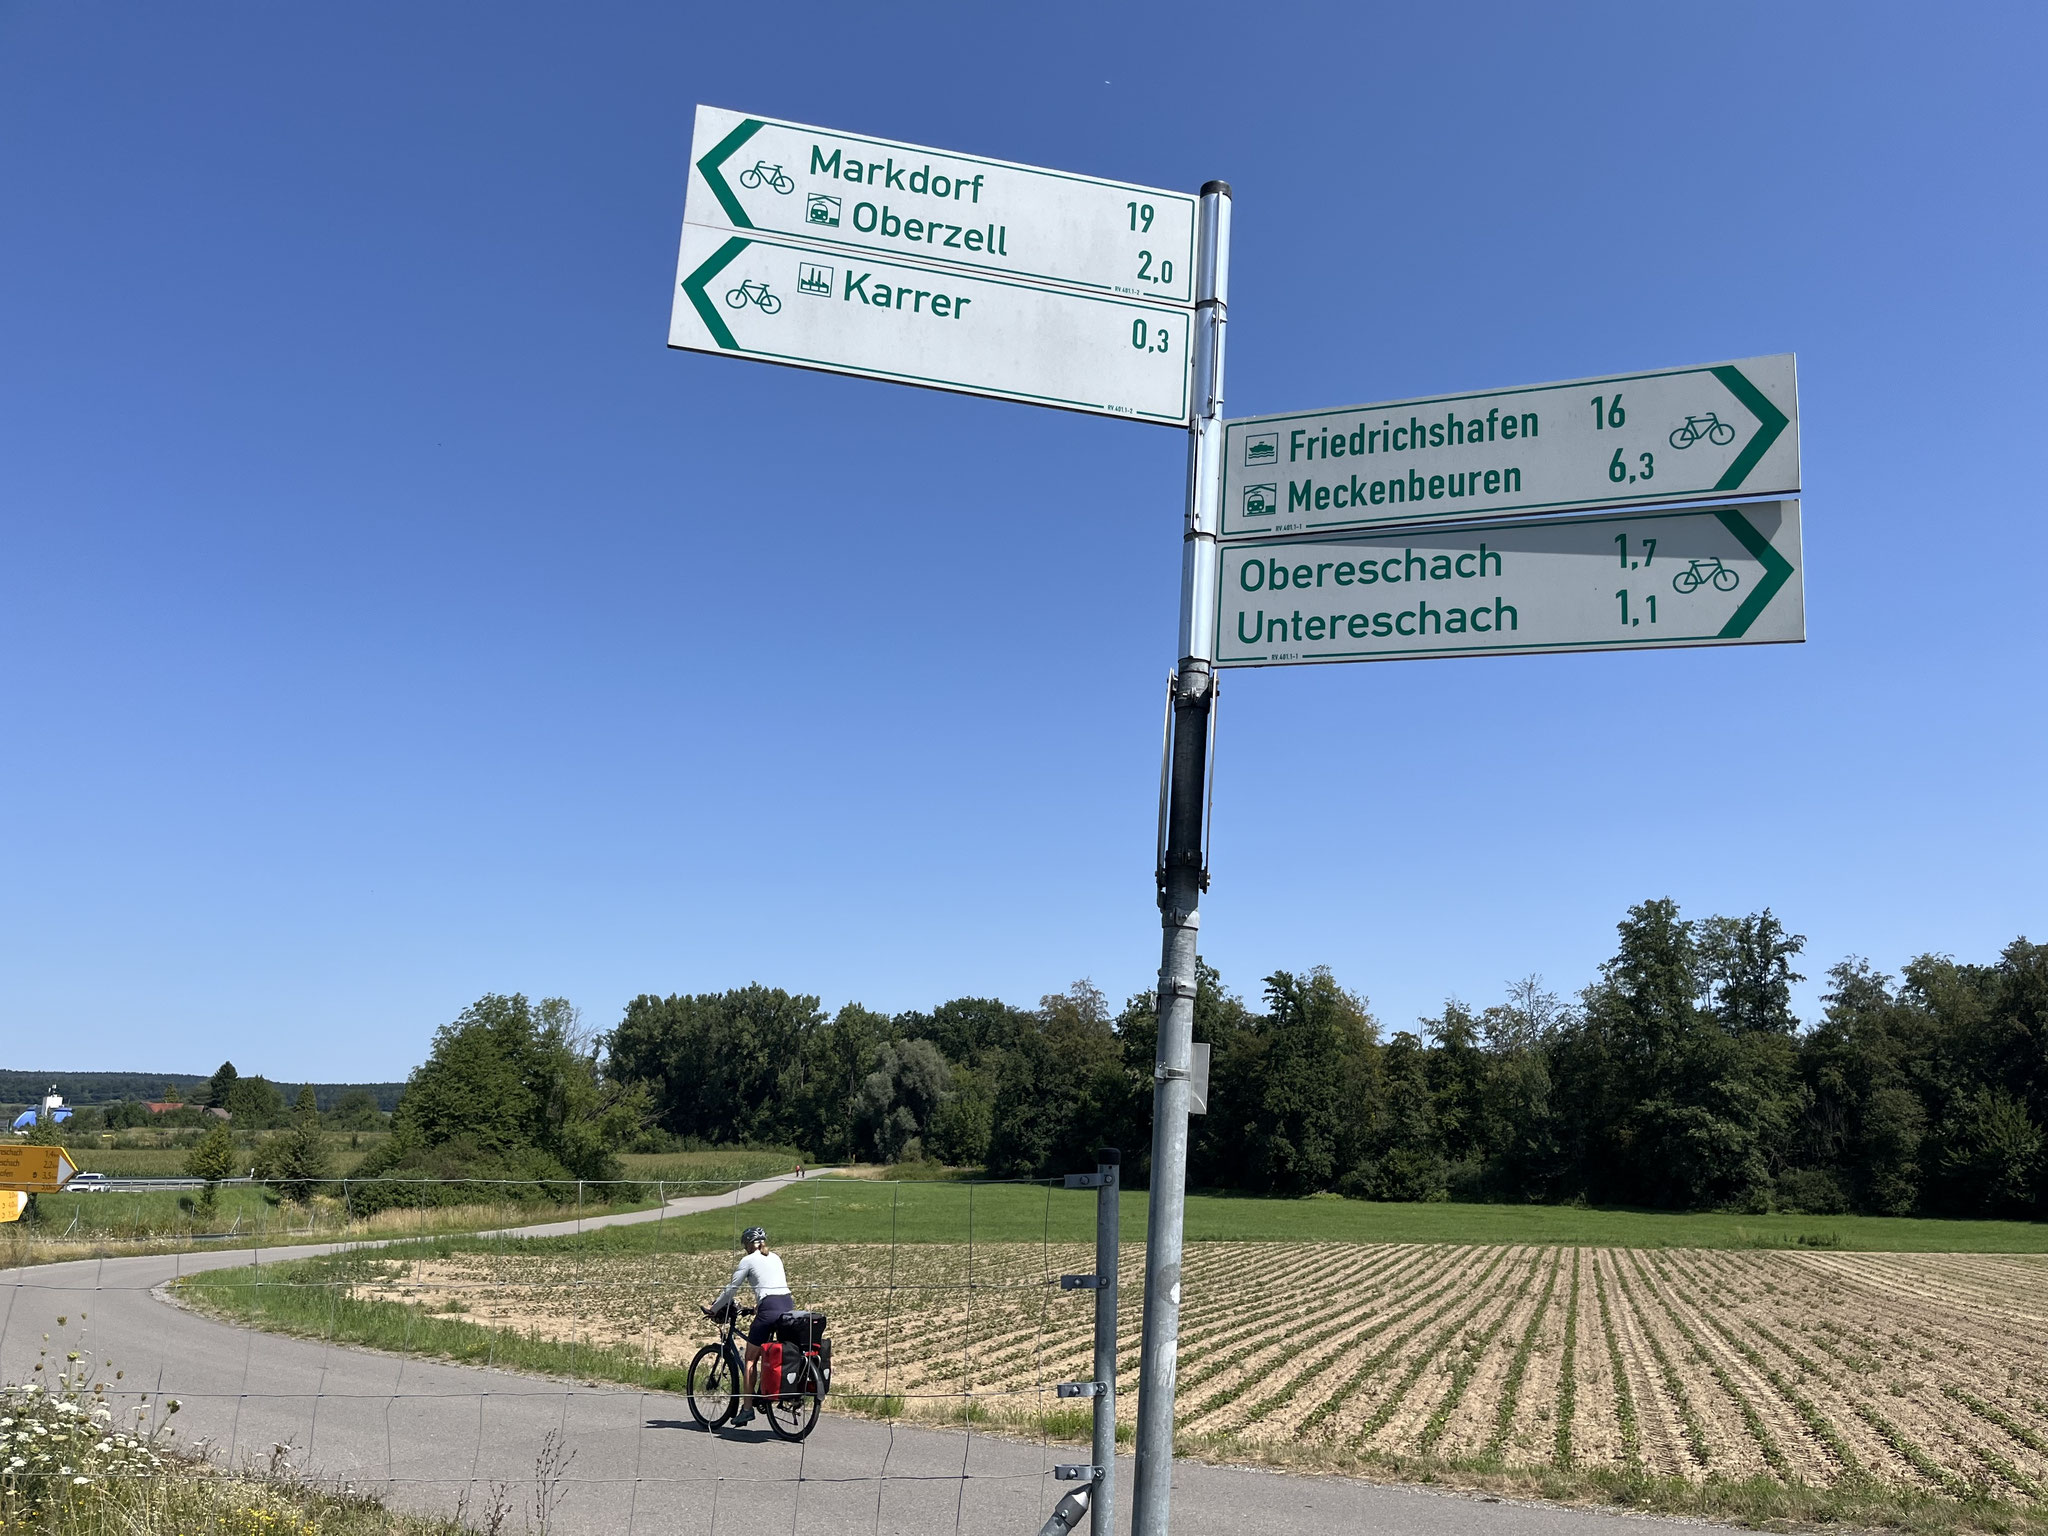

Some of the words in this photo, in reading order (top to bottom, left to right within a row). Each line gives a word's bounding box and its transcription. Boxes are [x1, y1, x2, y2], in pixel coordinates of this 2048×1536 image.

[810, 144, 986, 204] Markdorf
[1127, 200, 1156, 234] 19
[852, 200, 1009, 257] Oberzell
[1136, 249, 1174, 285] 2,0
[844, 269, 972, 321] Karrer
[1132, 317, 1170, 355] 0,3
[1289, 410, 1540, 464] Friedrichshafen
[1591, 393, 1626, 429] 16
[1287, 467, 1522, 513] Meckenbeuren
[1608, 446, 1655, 485] 6,3
[1239, 543, 1503, 592] Obereschach
[1614, 533, 1658, 570] 1,7
[1237, 596, 1519, 644] Untereschach
[1615, 588, 1658, 626] 1,1
